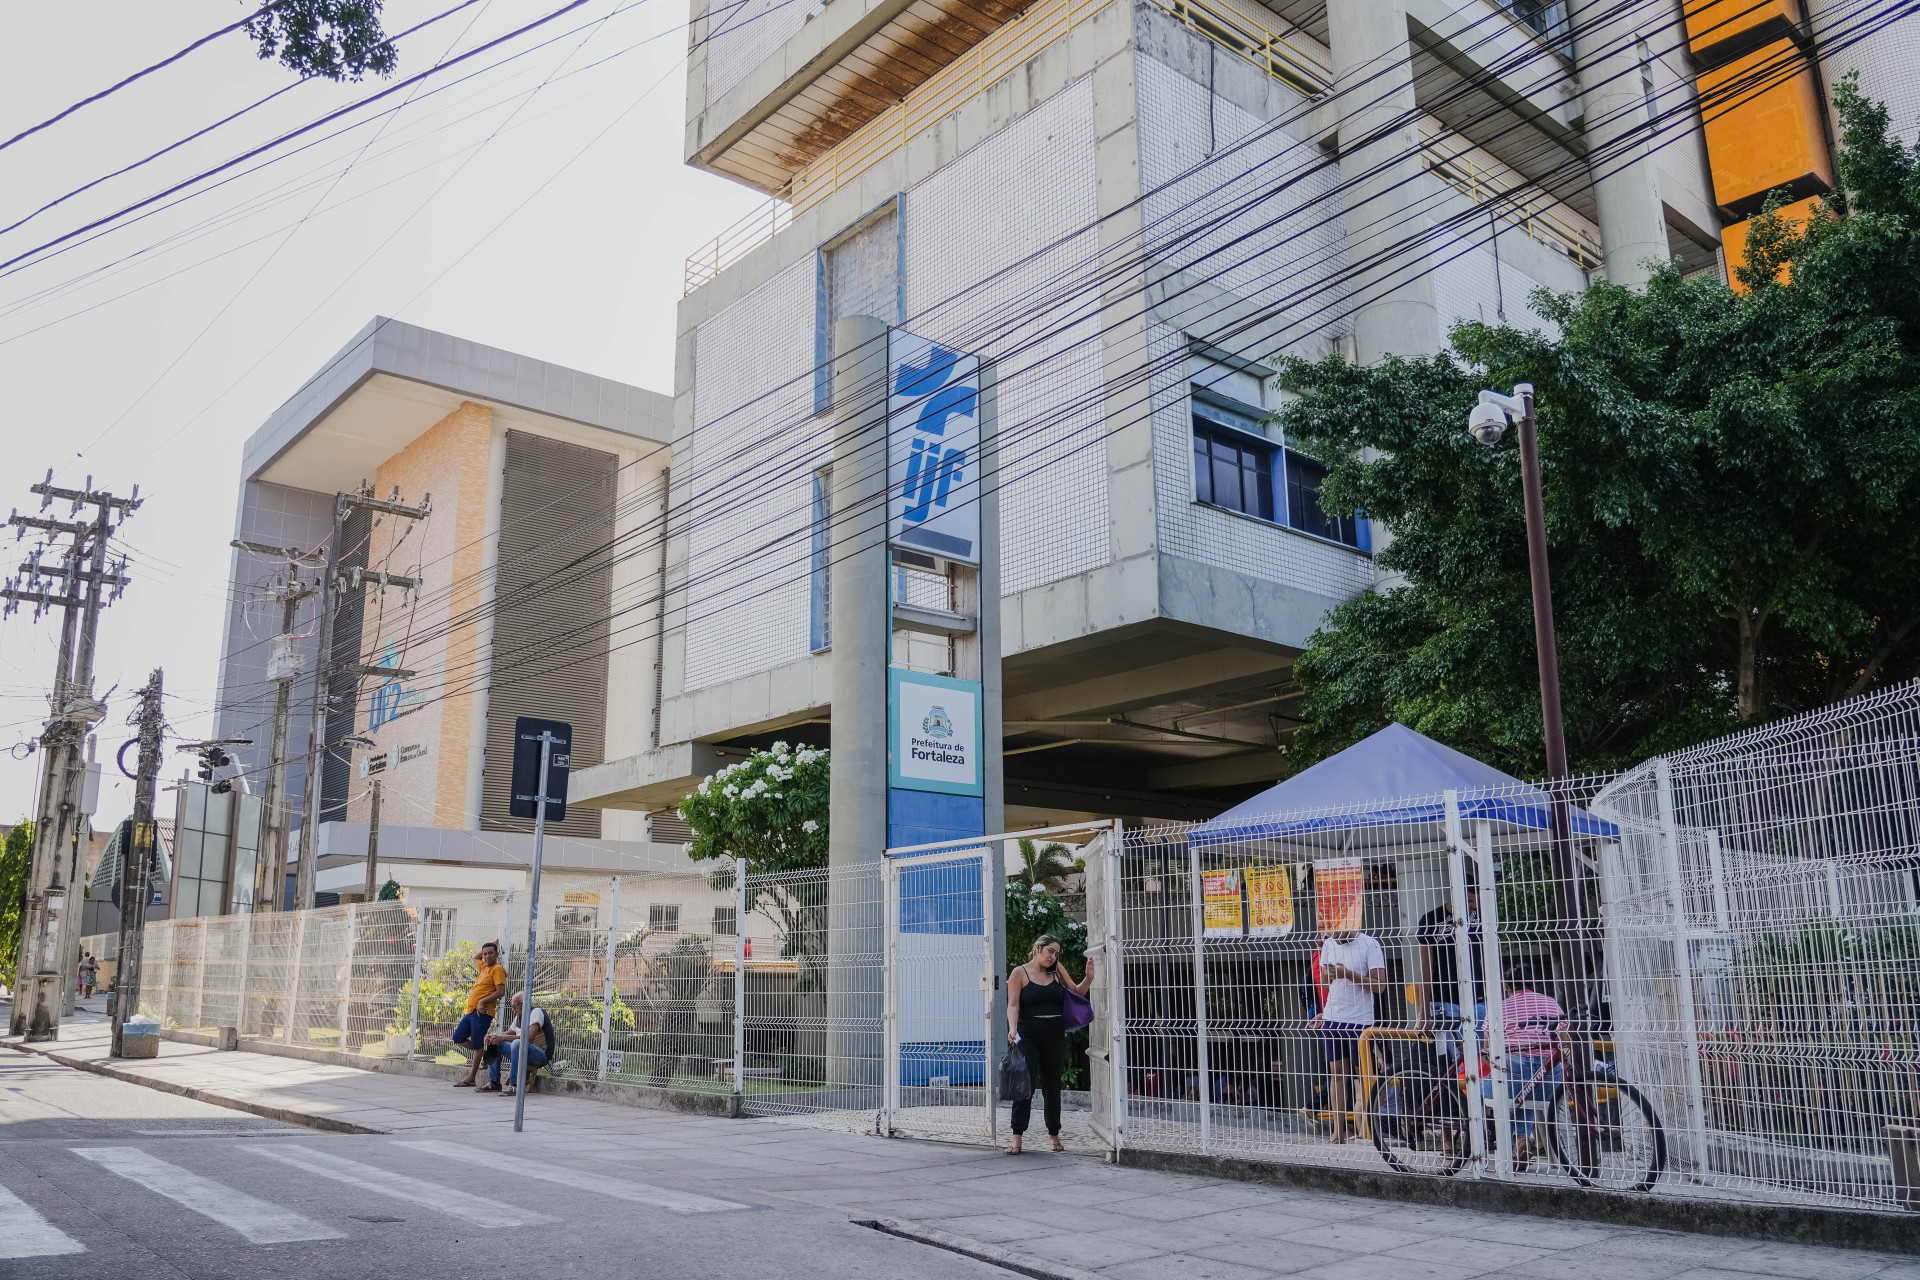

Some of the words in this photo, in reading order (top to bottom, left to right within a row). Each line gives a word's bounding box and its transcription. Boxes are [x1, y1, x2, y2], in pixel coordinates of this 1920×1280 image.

[903, 437, 967, 523] ijf
[911, 738, 952, 751] Prefeitura
[954, 743, 964, 752] de
[911, 747, 965, 765] Fortaleza
